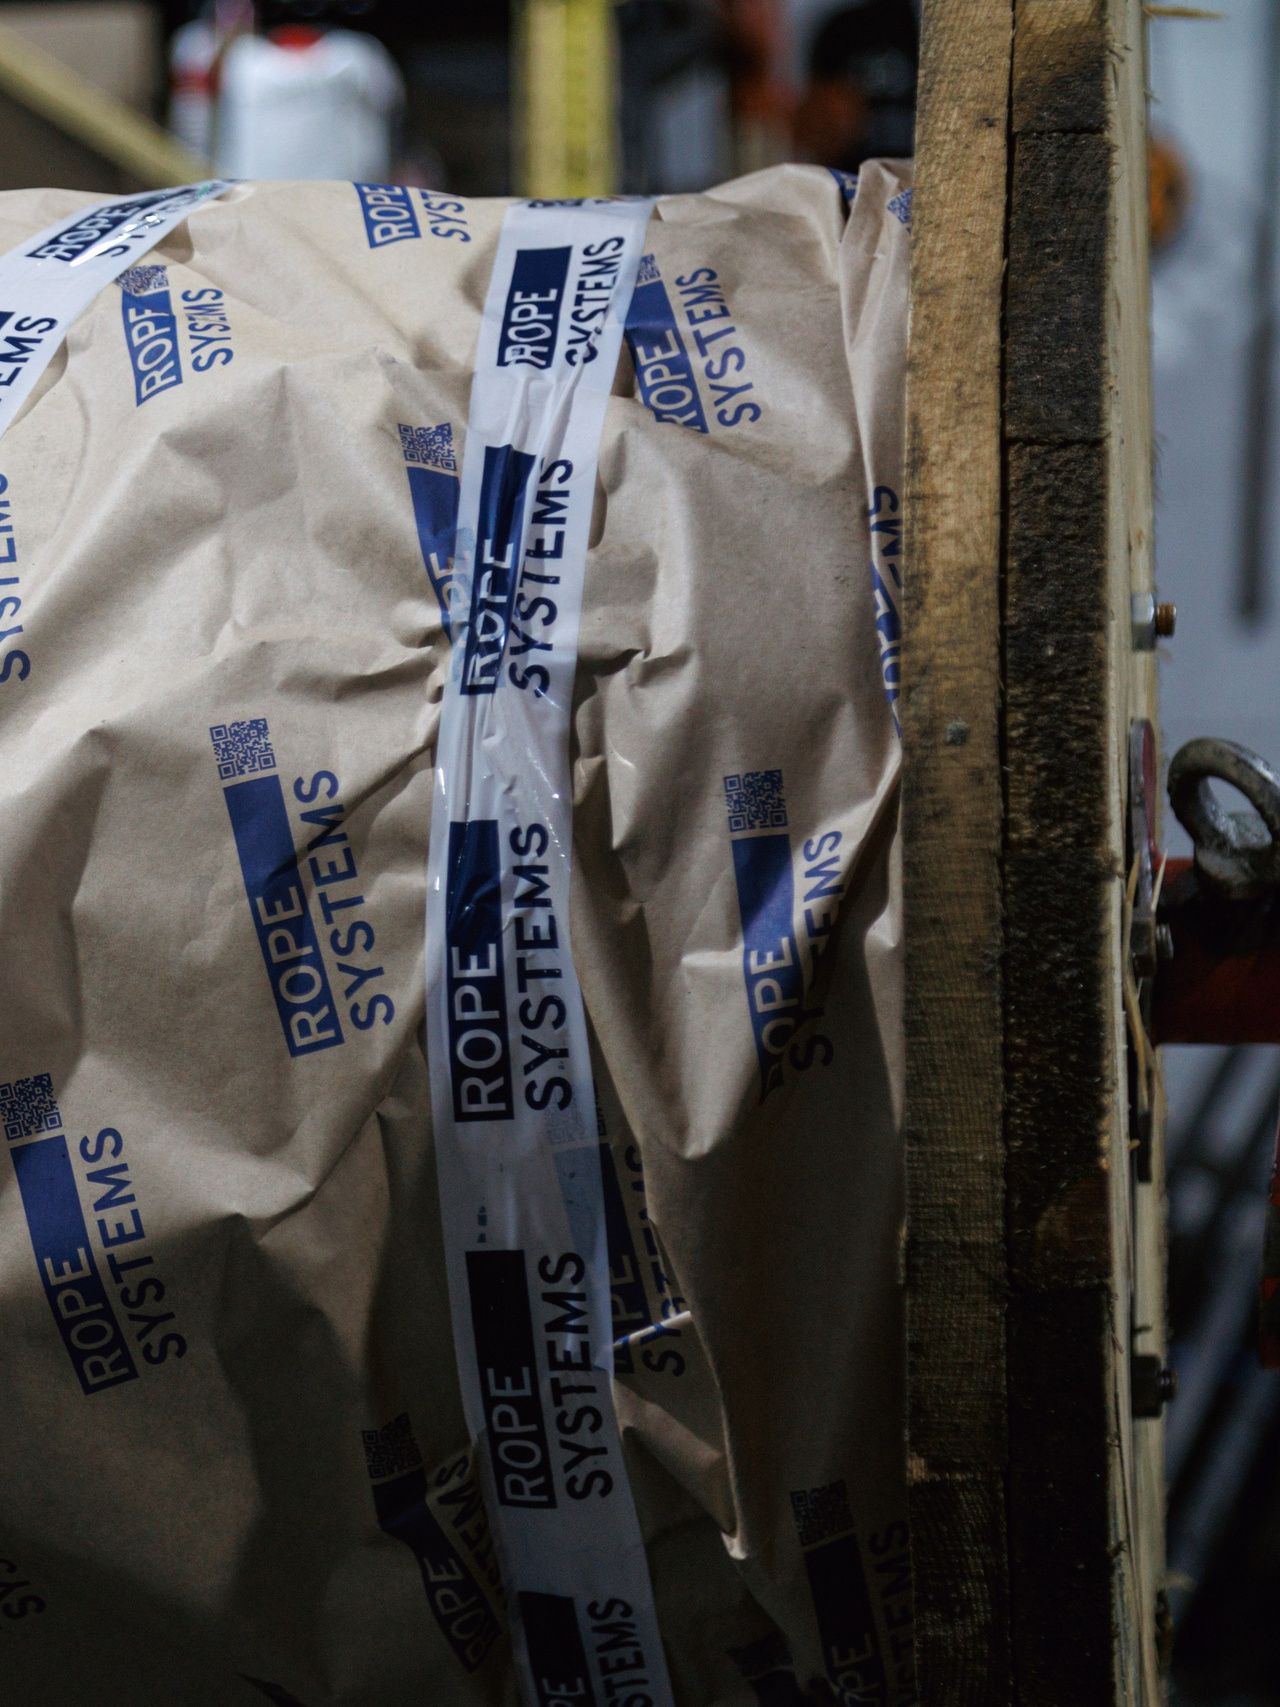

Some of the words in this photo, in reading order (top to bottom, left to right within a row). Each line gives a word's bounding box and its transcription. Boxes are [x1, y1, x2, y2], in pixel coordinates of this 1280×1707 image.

[505, 287, 558, 365] ROPE
[674, 267, 762, 428] SYSTEMS
[466, 538, 515, 686] ROPE
[508, 457, 573, 698] SYSTEMS
[255, 886, 336, 1048] ROPE
[293, 769, 395, 1031] SYSTEMS
[509, 822, 573, 1112] SYSTEMS
[451, 942, 508, 1113] ROPE
[43, 1247, 131, 1387] ROPE
[79, 1126, 187, 1366] SYSTEMS
[488, 1366, 550, 1502] ROPE
[538, 1251, 614, 1500] SYSTEMS
